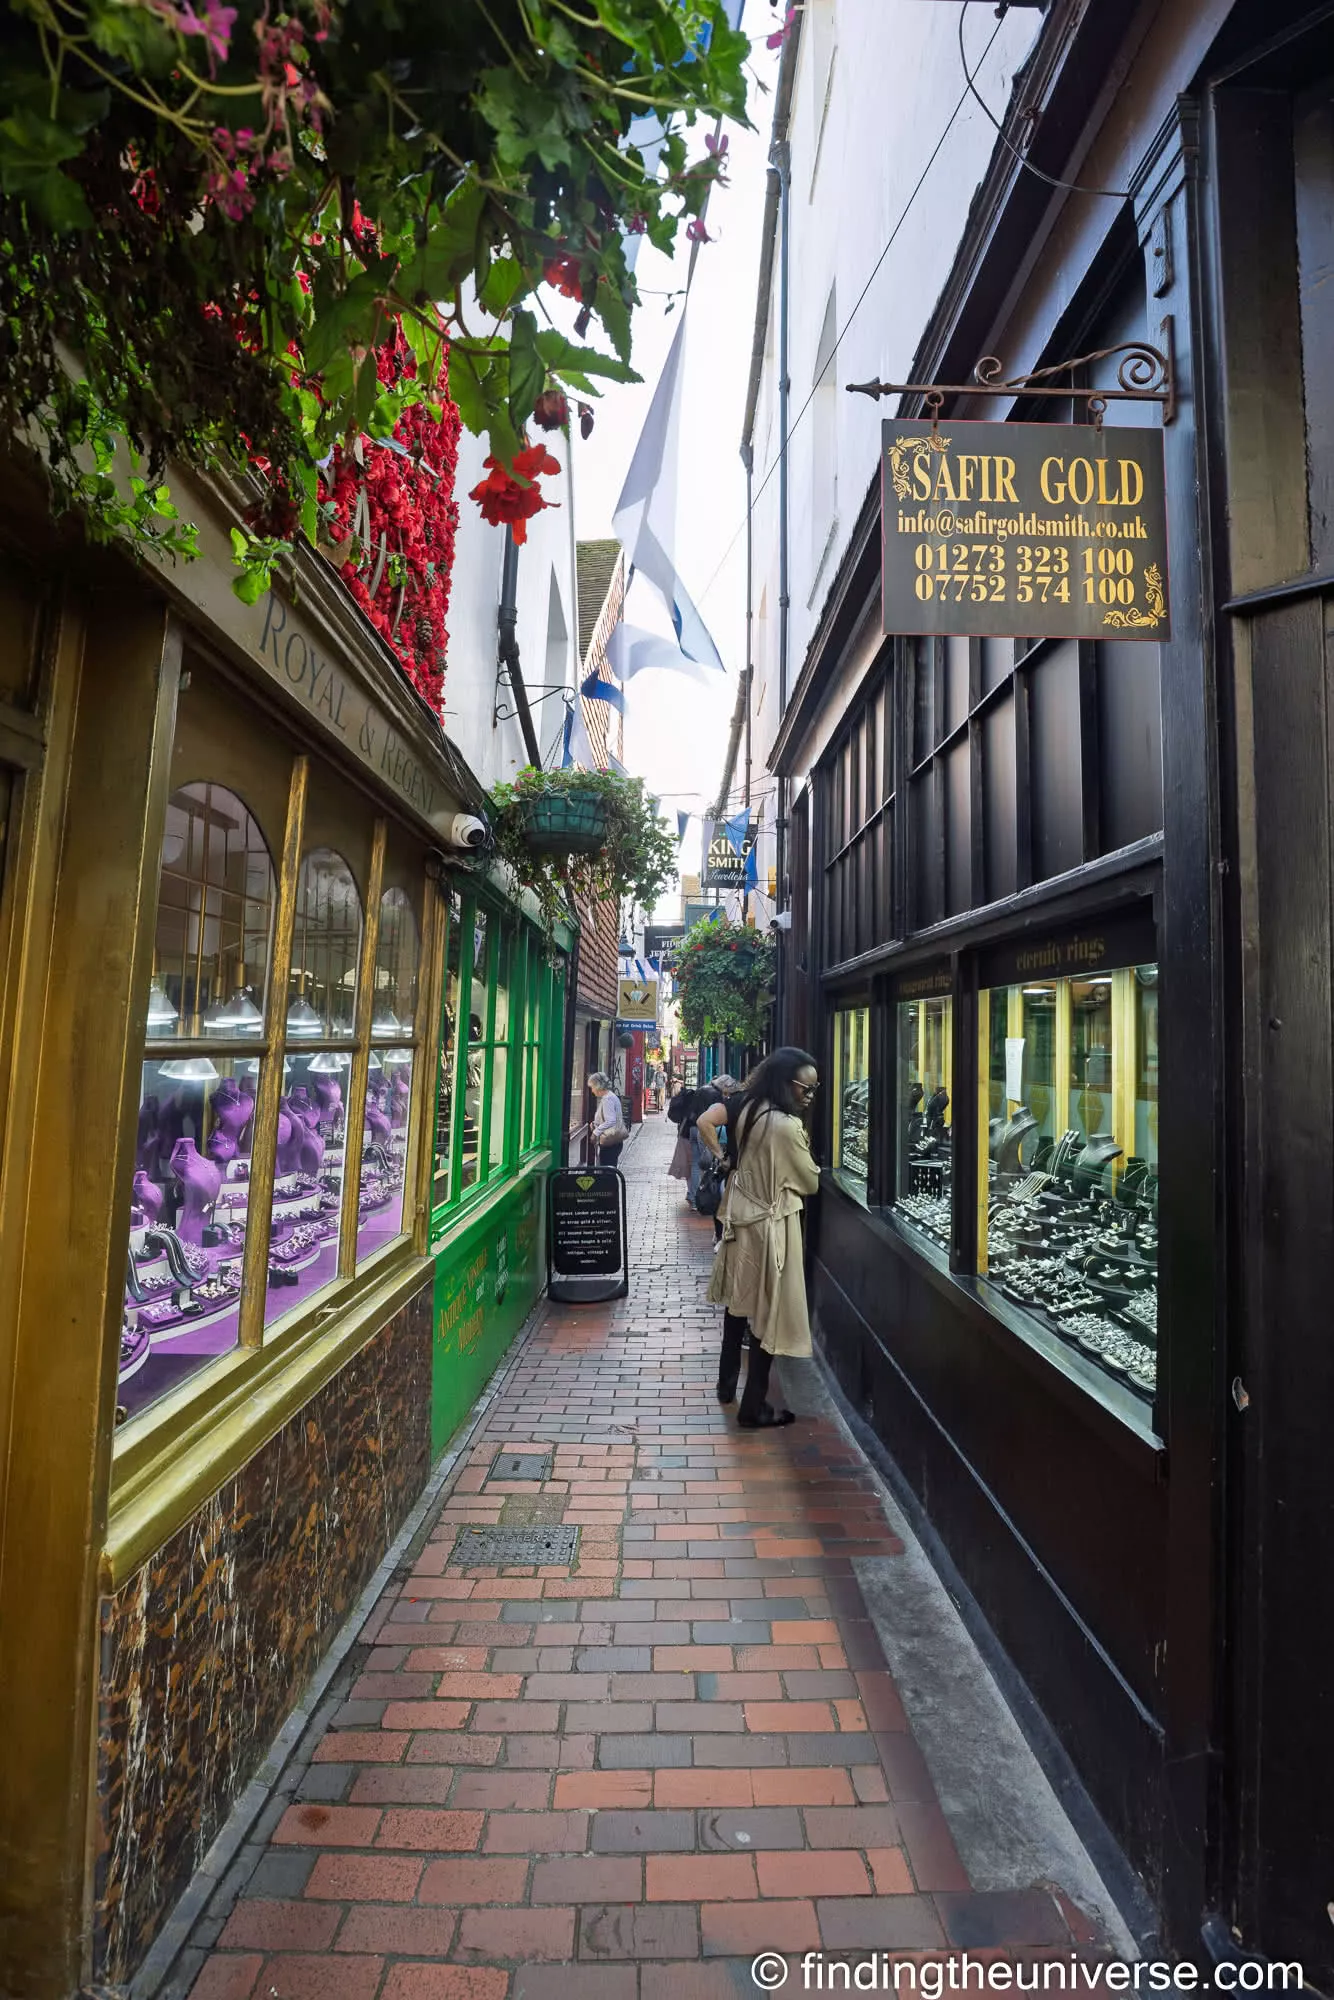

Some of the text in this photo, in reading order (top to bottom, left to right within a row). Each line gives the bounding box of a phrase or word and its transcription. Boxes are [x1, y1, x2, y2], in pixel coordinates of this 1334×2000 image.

[913, 454, 1144, 505] SAFIR GOLD
[897, 509, 1148, 541] info@safirgoldsmith.co.uk
[915, 543, 1134, 575] 01273 323 100
[915, 574, 1135, 605] 07752 574 100
[259, 593, 437, 815] ROYAL & REGENT
[708, 838, 752, 856] KING
[1016, 934, 1106, 971] eternity rings
